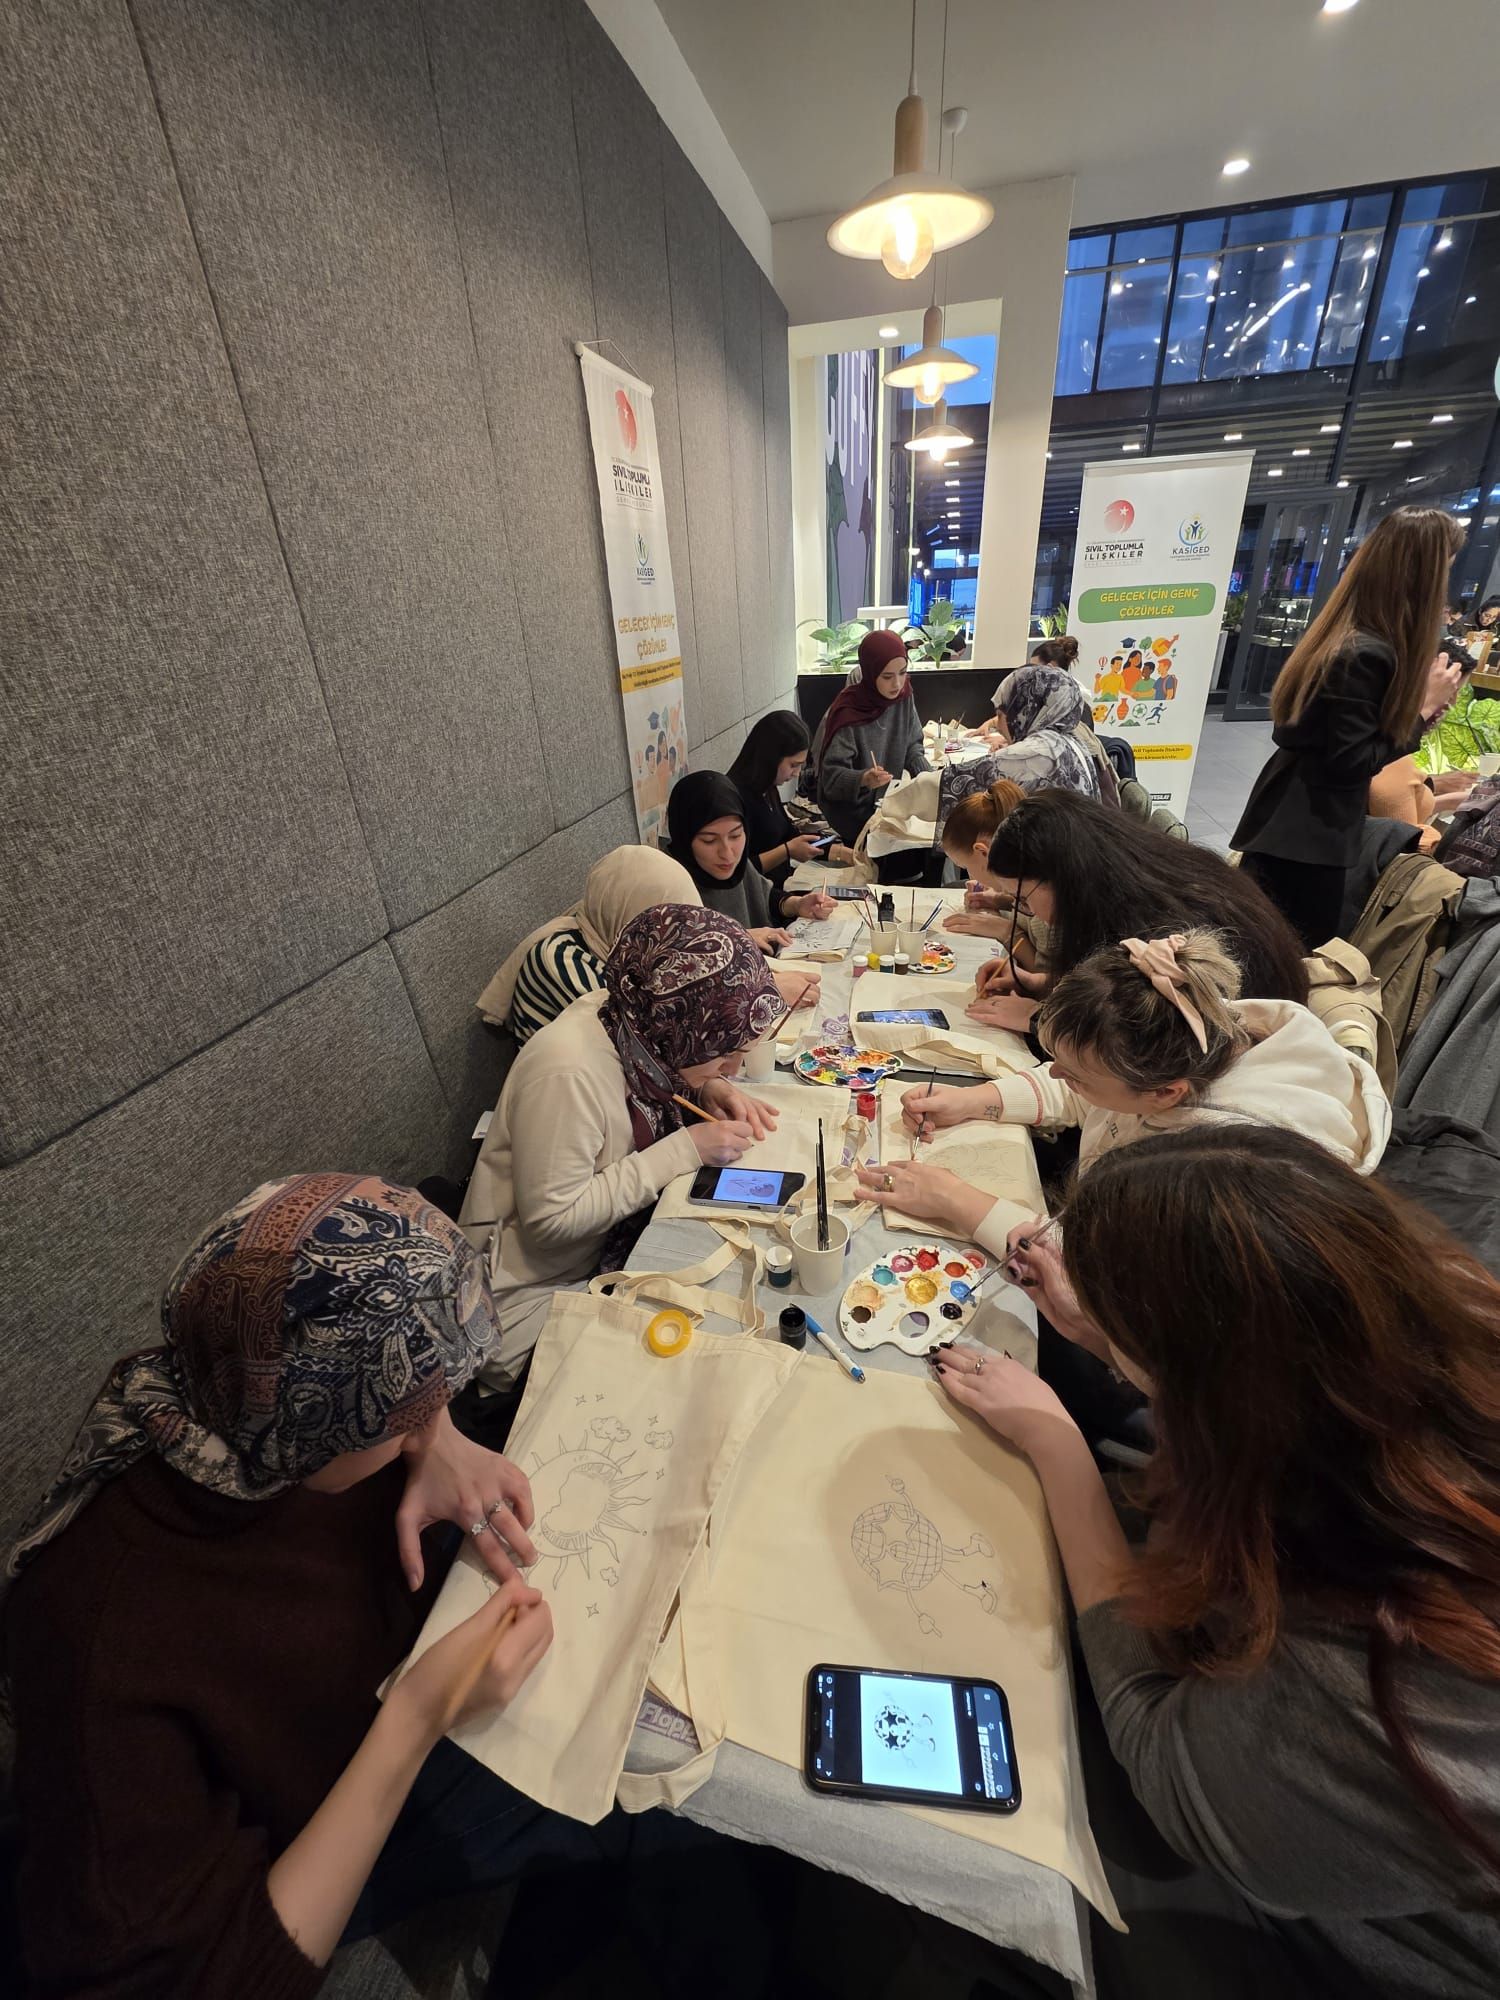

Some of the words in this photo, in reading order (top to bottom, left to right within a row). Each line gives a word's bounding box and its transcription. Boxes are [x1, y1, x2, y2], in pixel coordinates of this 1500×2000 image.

[1105, 543, 1144, 551] TOPLUMLA
[1100, 591, 1145, 603] GELECEK
[1147, 588, 1168, 601] İÇİN
[1170, 588, 1200, 599] GENÇ
[1119, 604, 1175, 619] ÇÖZÜMLER
